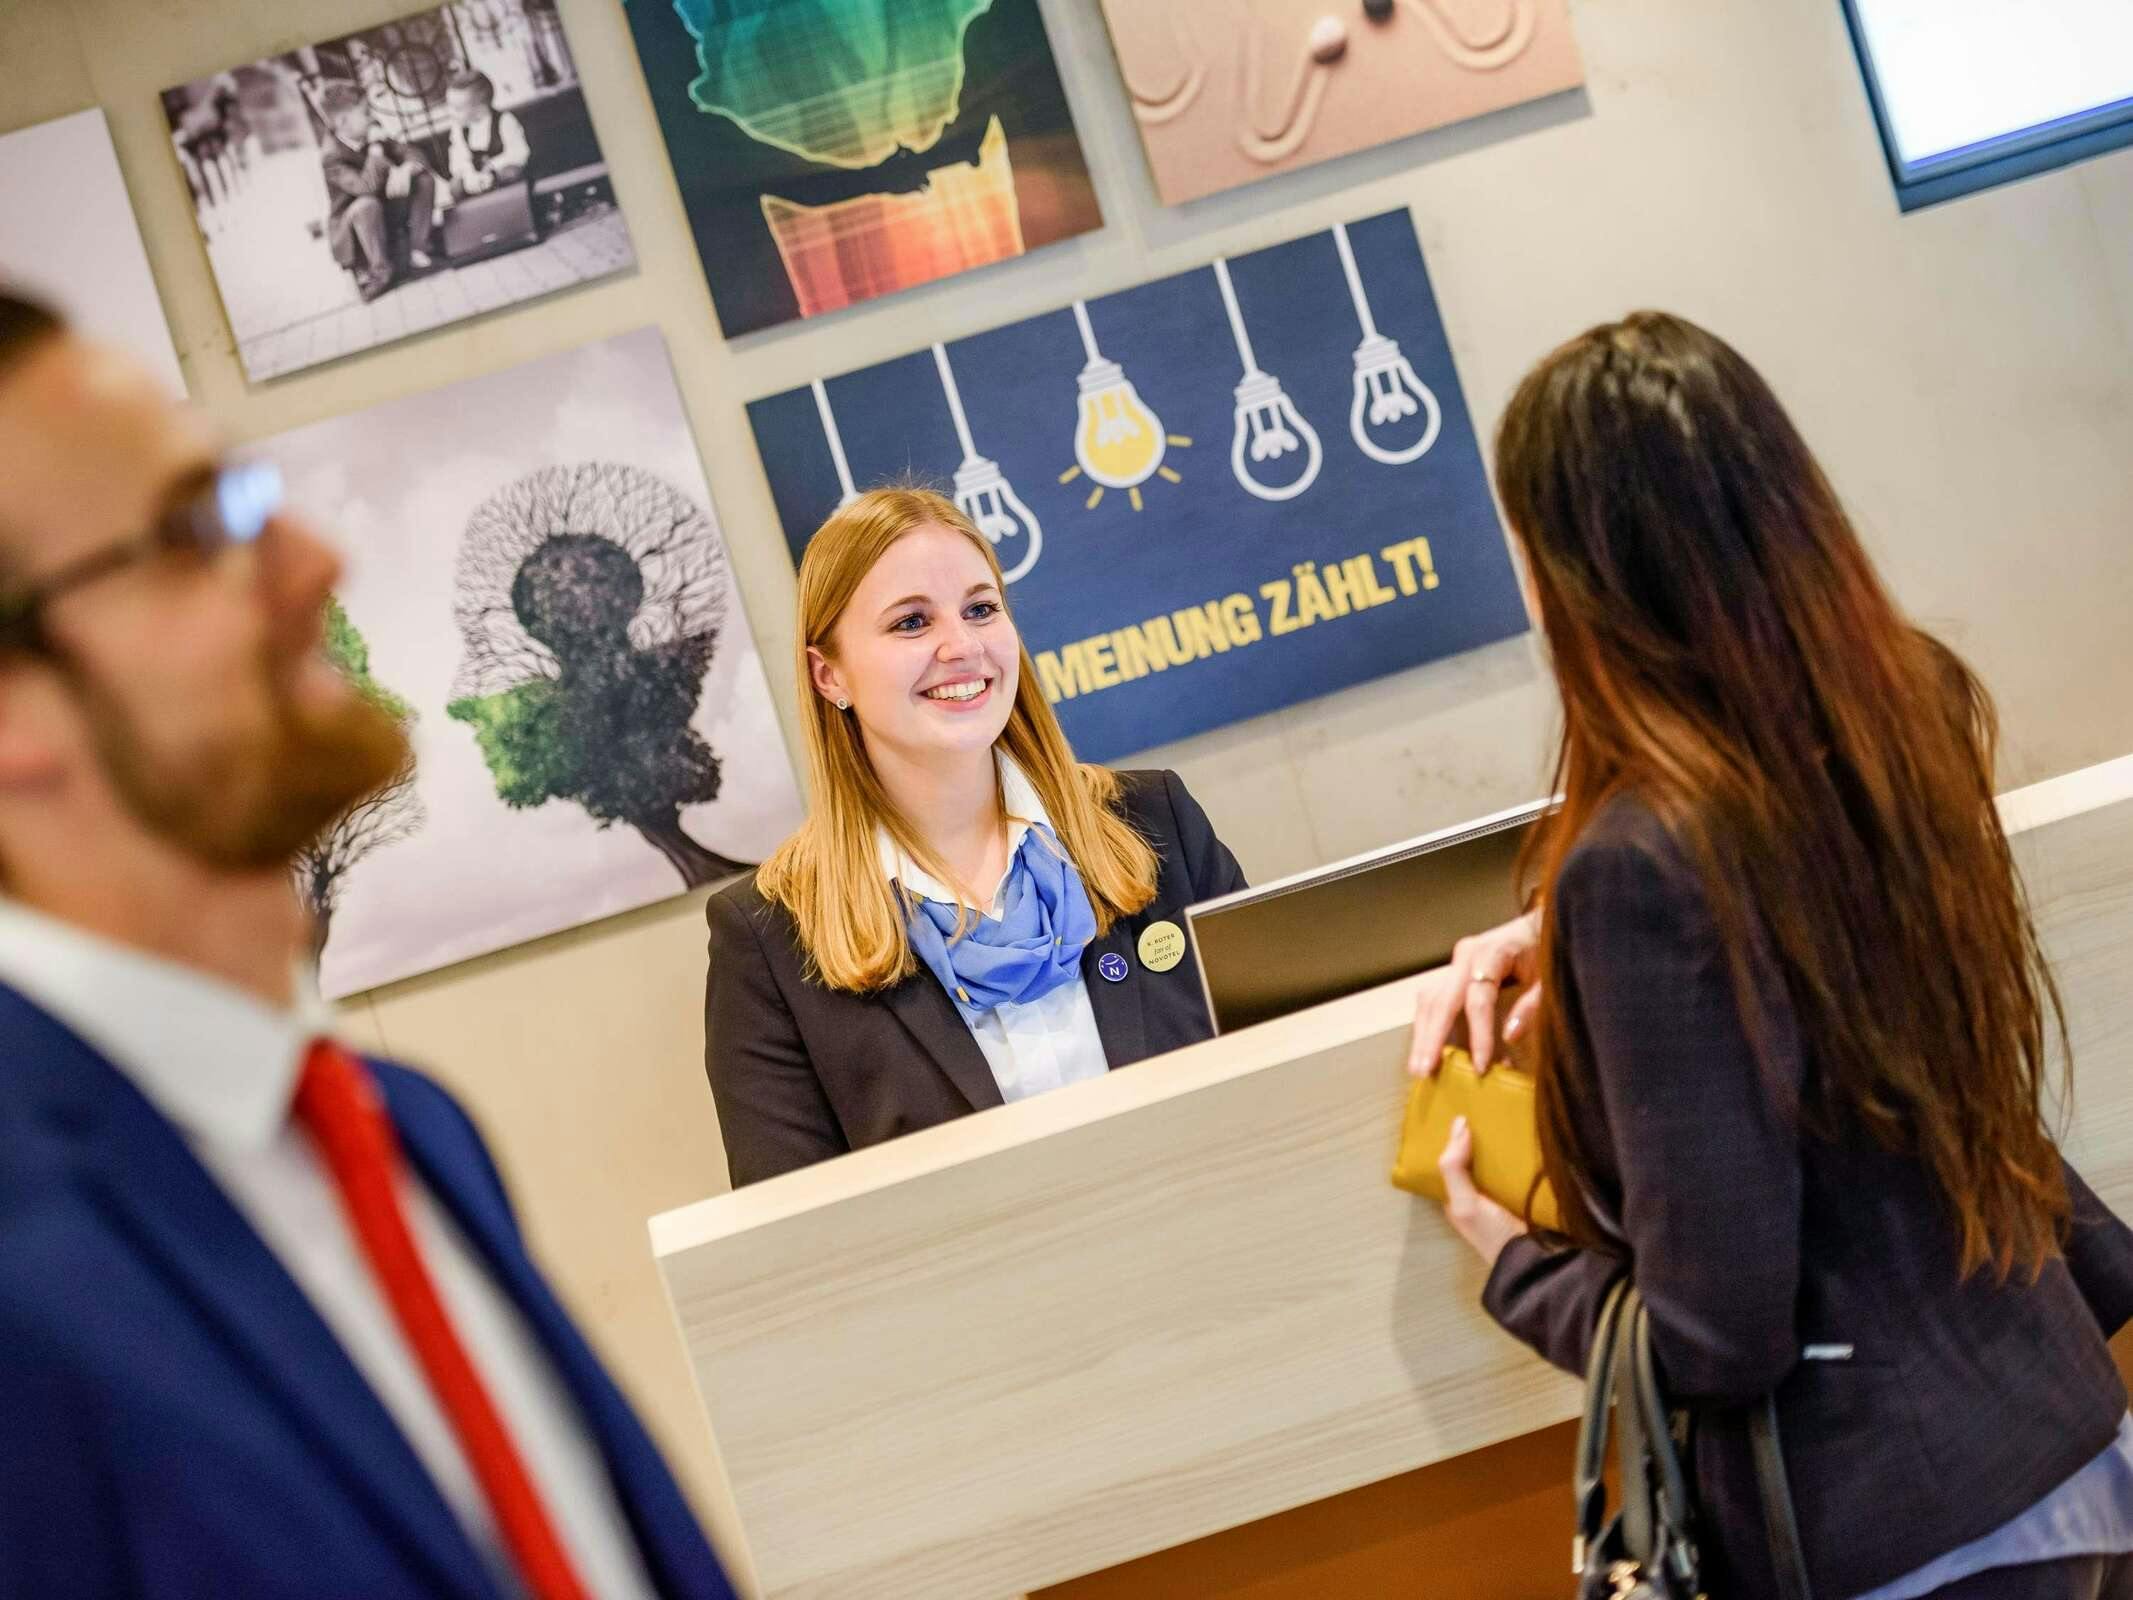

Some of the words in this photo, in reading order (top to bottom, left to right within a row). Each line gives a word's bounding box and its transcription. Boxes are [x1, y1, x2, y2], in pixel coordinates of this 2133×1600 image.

[1034, 592, 1262, 704] MEINUNG
[1259, 536, 1440, 636] ZÄHLT!
[1148, 951, 1180, 965] NOVOTEL
[1109, 967, 1120, 976] N
